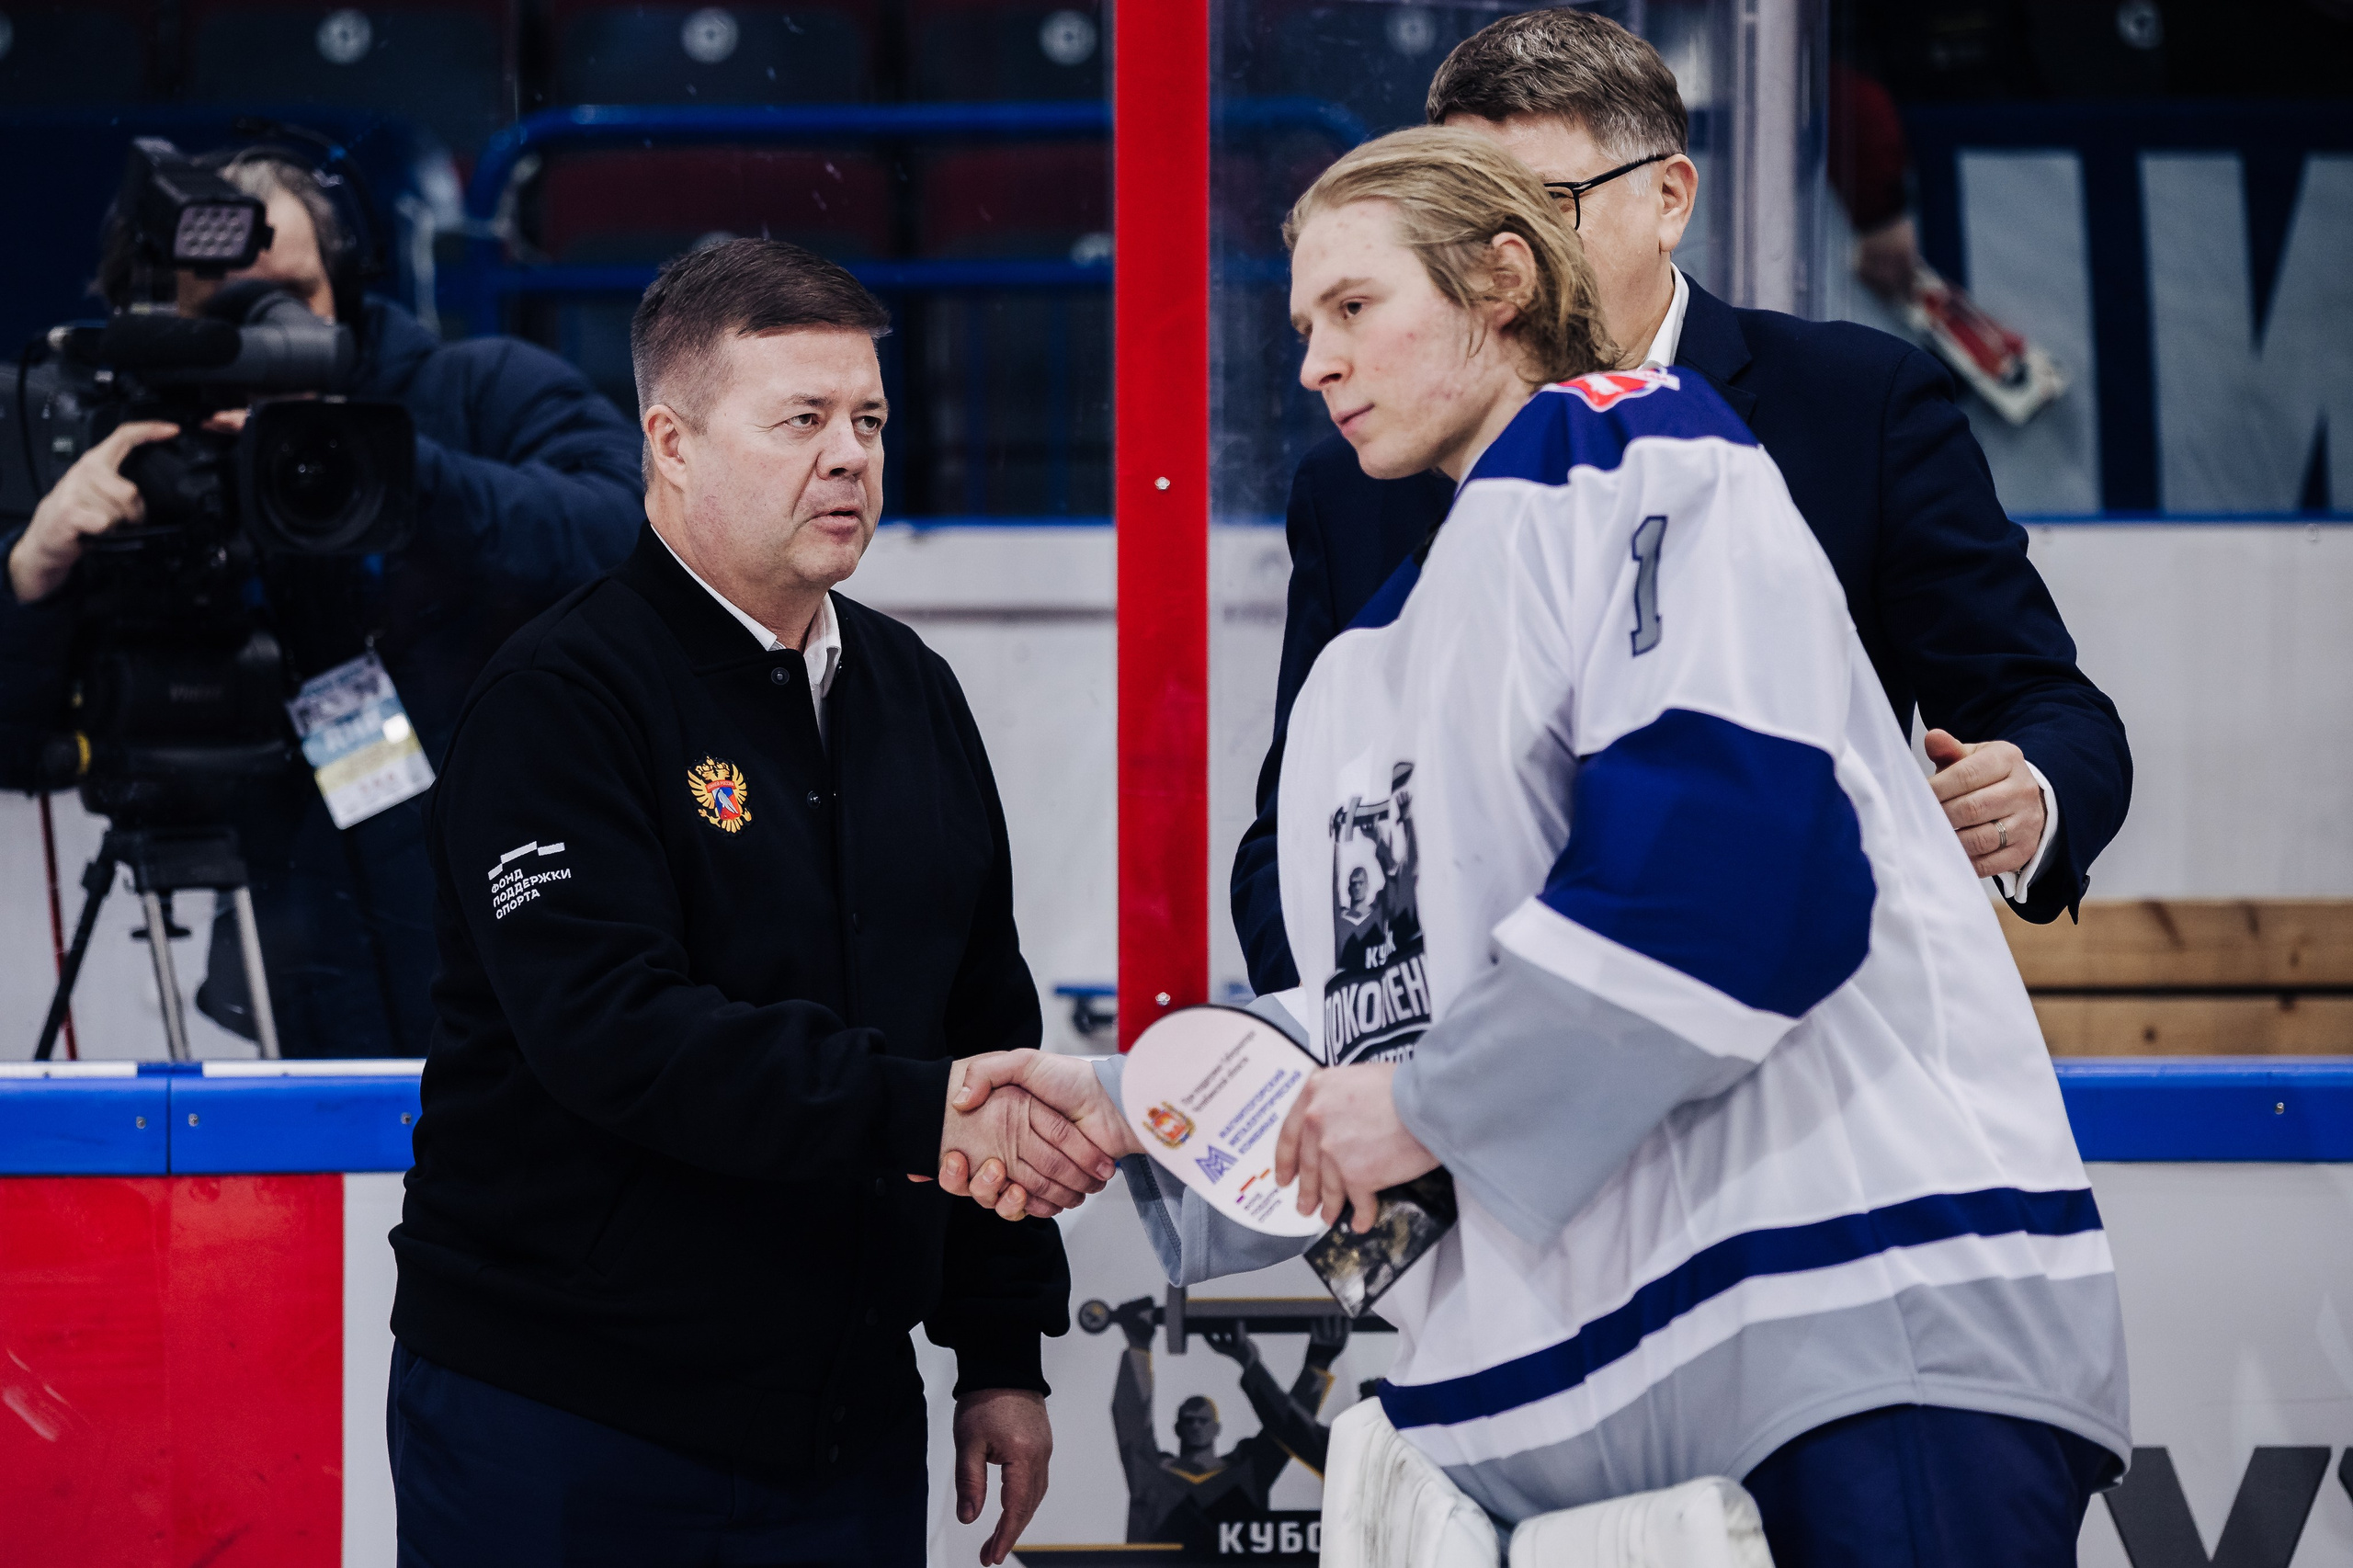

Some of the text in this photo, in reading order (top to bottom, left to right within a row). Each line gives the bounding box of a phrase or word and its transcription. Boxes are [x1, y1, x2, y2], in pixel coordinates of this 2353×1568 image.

[1631, 515, 1668, 658] 1
[491, 869, 524, 893] ФОНД
[493, 868, 572, 908] ПОДДЕРЖКИ
[495, 889, 540, 919] СПОРТА
[1219, 1521, 1321, 1553] КУБО
